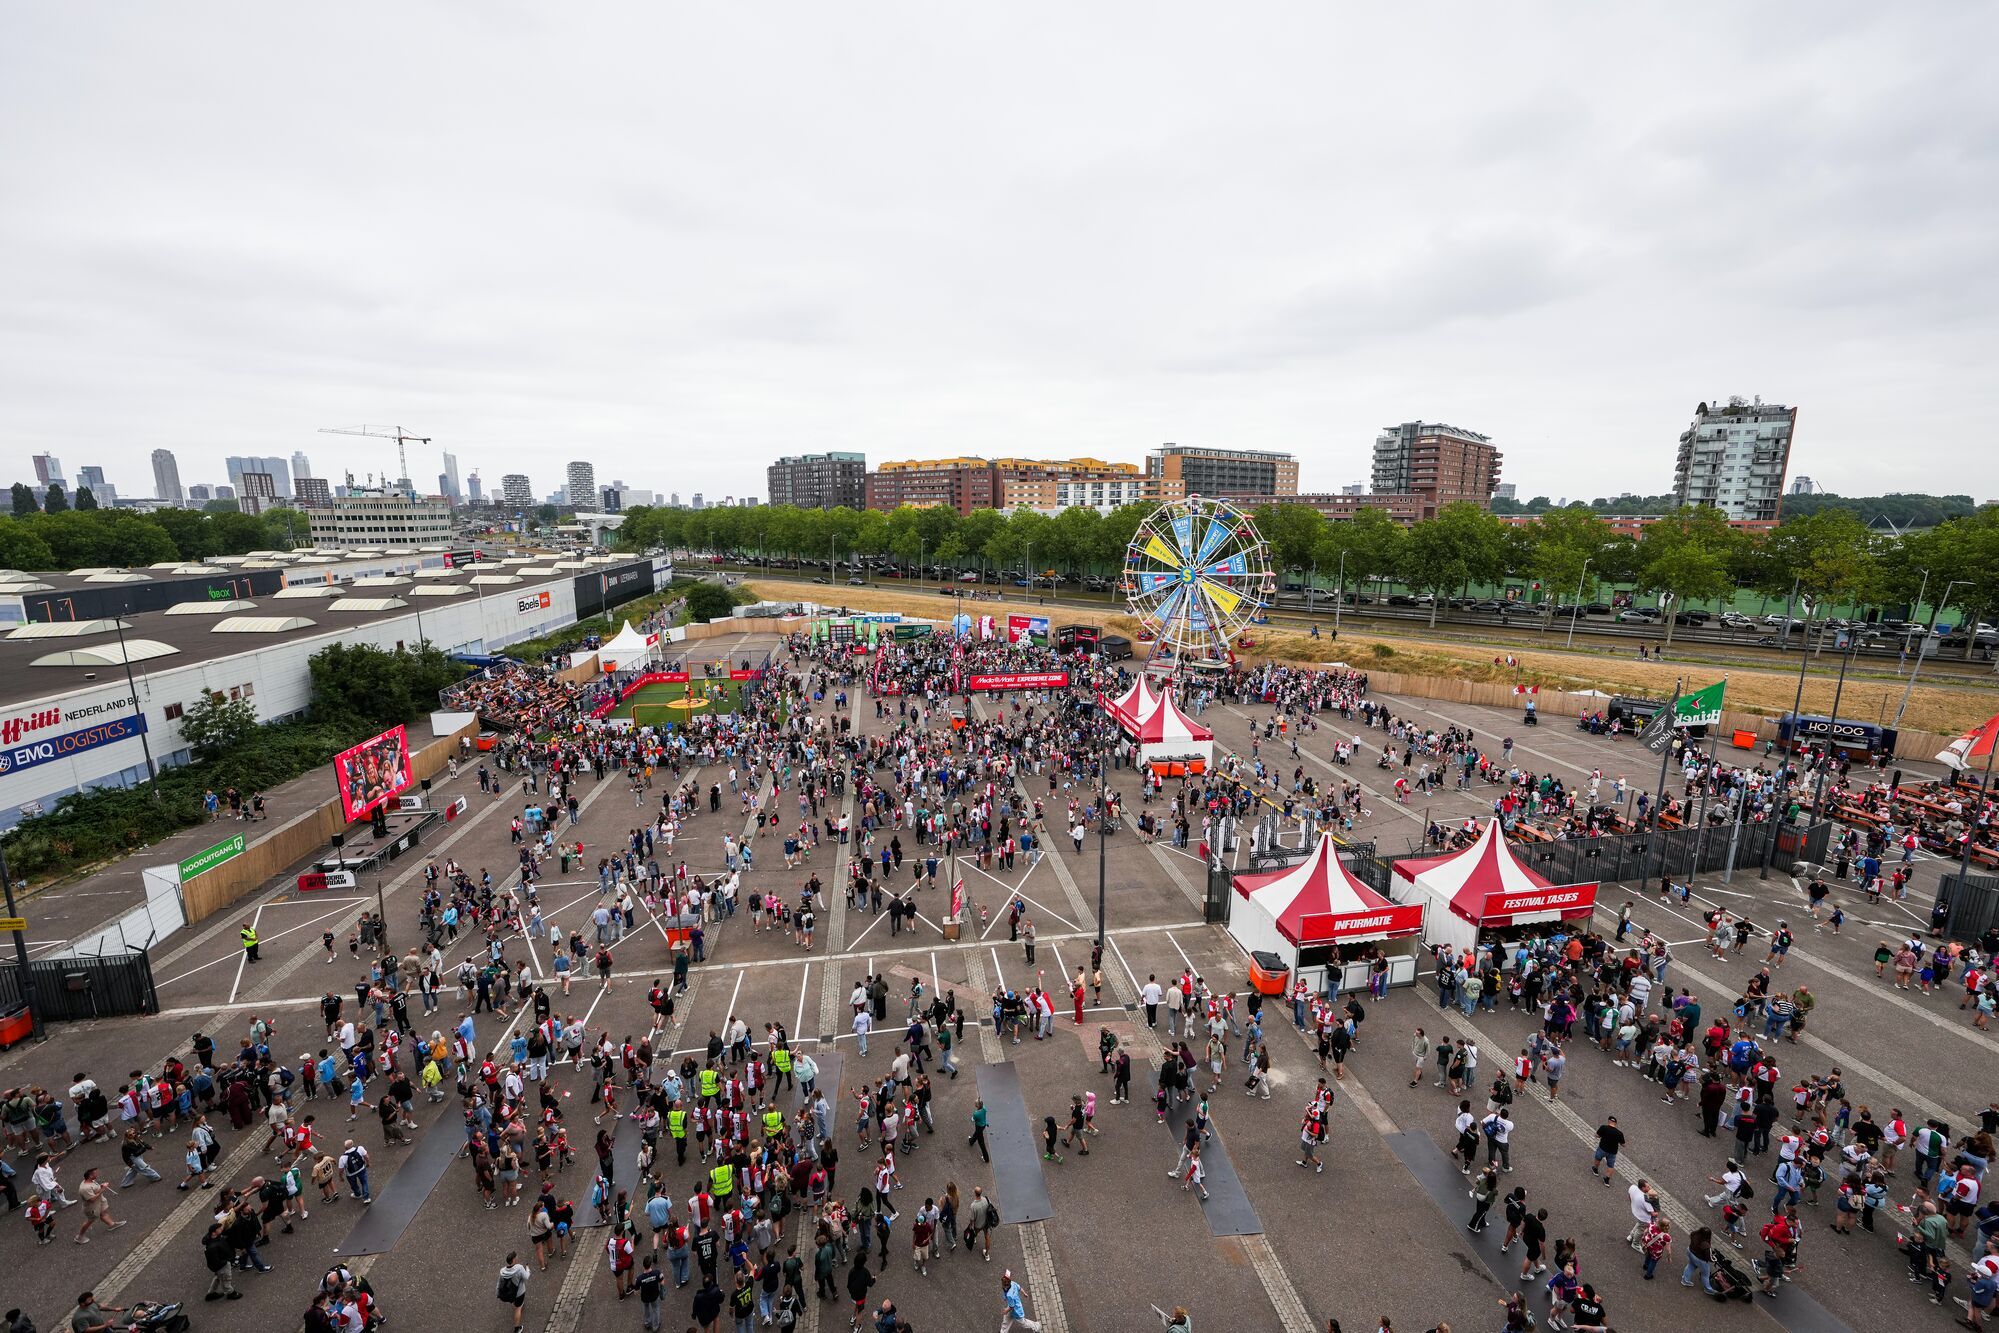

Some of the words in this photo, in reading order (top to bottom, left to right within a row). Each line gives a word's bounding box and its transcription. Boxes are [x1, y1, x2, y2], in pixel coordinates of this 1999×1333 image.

[519, 598, 540, 612] Boels
[65, 697, 126, 721] NEDERLAND
[1809, 722, 1831, 732] HO
[1834, 725, 1865, 736] DOG
[14, 744, 54, 766] EMQ
[56, 722, 126, 753] LOGISTICS
[182, 844, 234, 874] NOODUITGANG
[1503, 897, 1546, 909] FESTIVAL
[1545, 892, 1579, 905] TASJES
[1334, 915, 1393, 930] INFORMATIE
